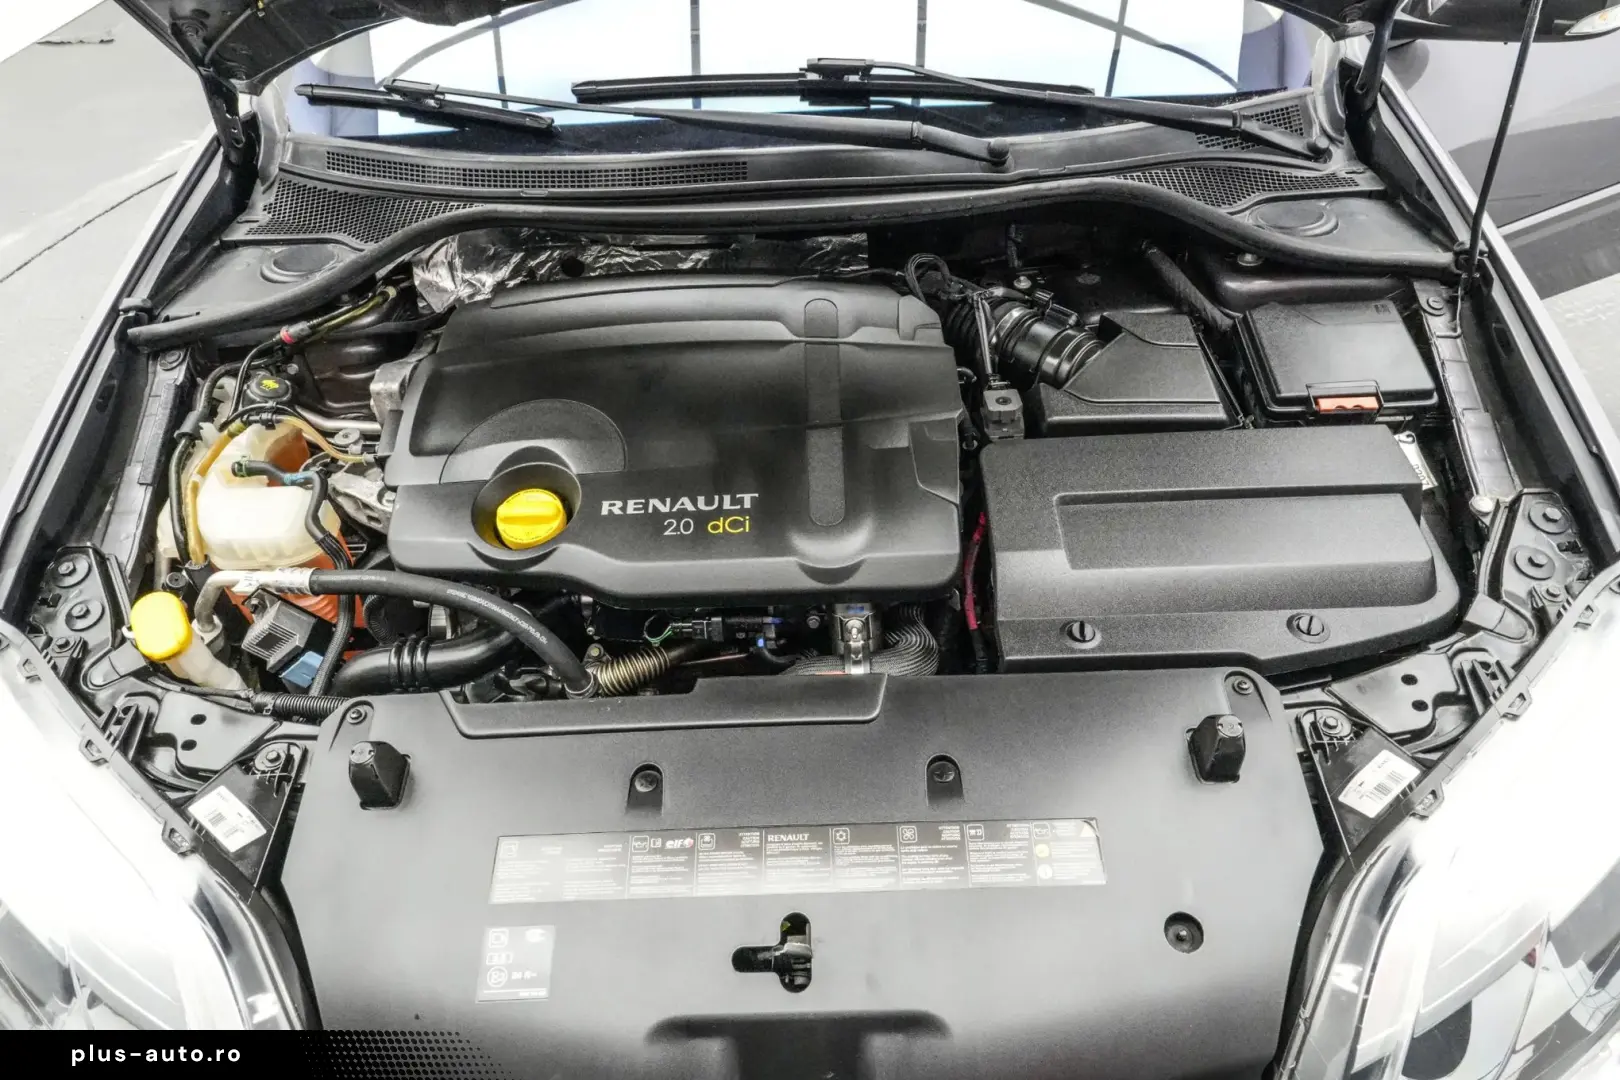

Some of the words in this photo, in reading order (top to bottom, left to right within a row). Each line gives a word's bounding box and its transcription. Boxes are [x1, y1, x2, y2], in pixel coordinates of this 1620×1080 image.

[601, 493, 759, 515] RENAULT
[663, 518, 694, 535] 2.0
[707, 516, 750, 534] dCi
[767, 833, 810, 842] RENAULT
